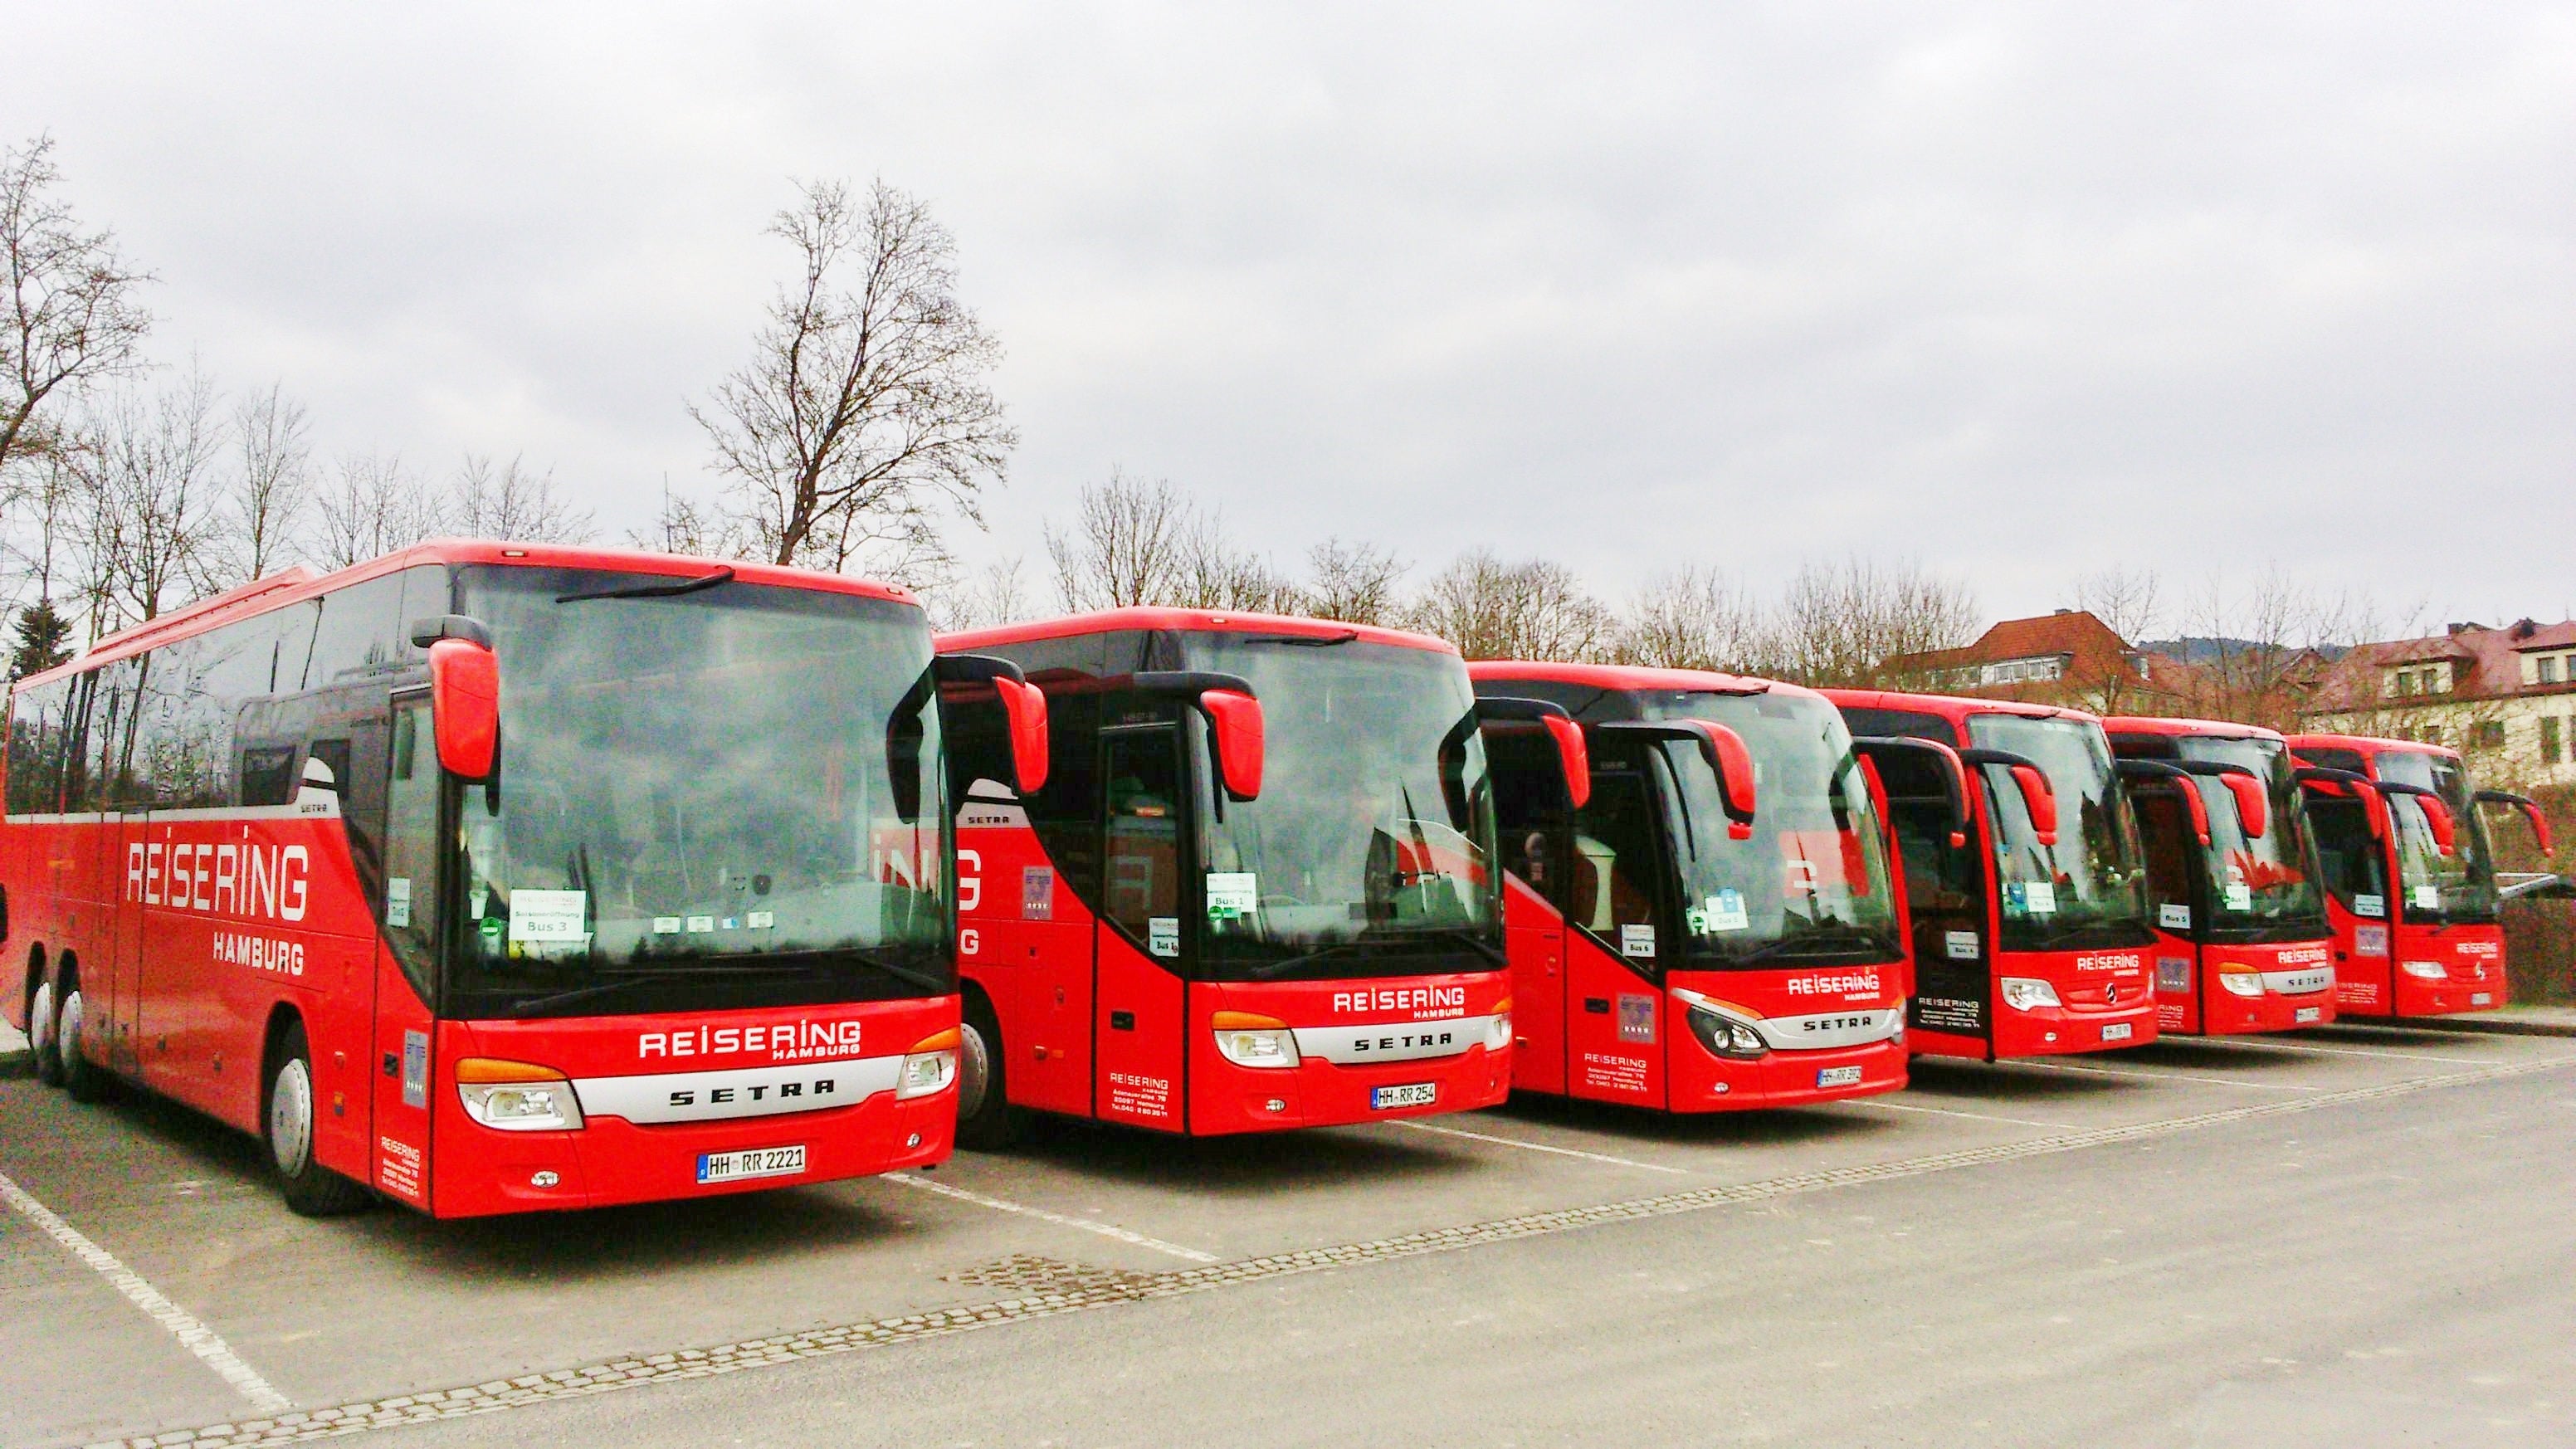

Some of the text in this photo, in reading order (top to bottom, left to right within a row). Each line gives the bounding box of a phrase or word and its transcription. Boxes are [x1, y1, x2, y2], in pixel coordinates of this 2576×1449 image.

[528, 922, 567, 931] Bus 3
[213, 932, 304, 976] HAMBURG
[1413, 1007, 1464, 1019] HAMBURG
[1803, 1017, 1871, 1032] SETRA
[1354, 1032, 1451, 1051] SETRA
[773, 1043, 860, 1060] HAMBURG
[670, 1079, 834, 1106] SETRA
[1378, 1086, 1433, 1104] HH RR 254
[709, 1149, 803, 1175] HH RR 2221
